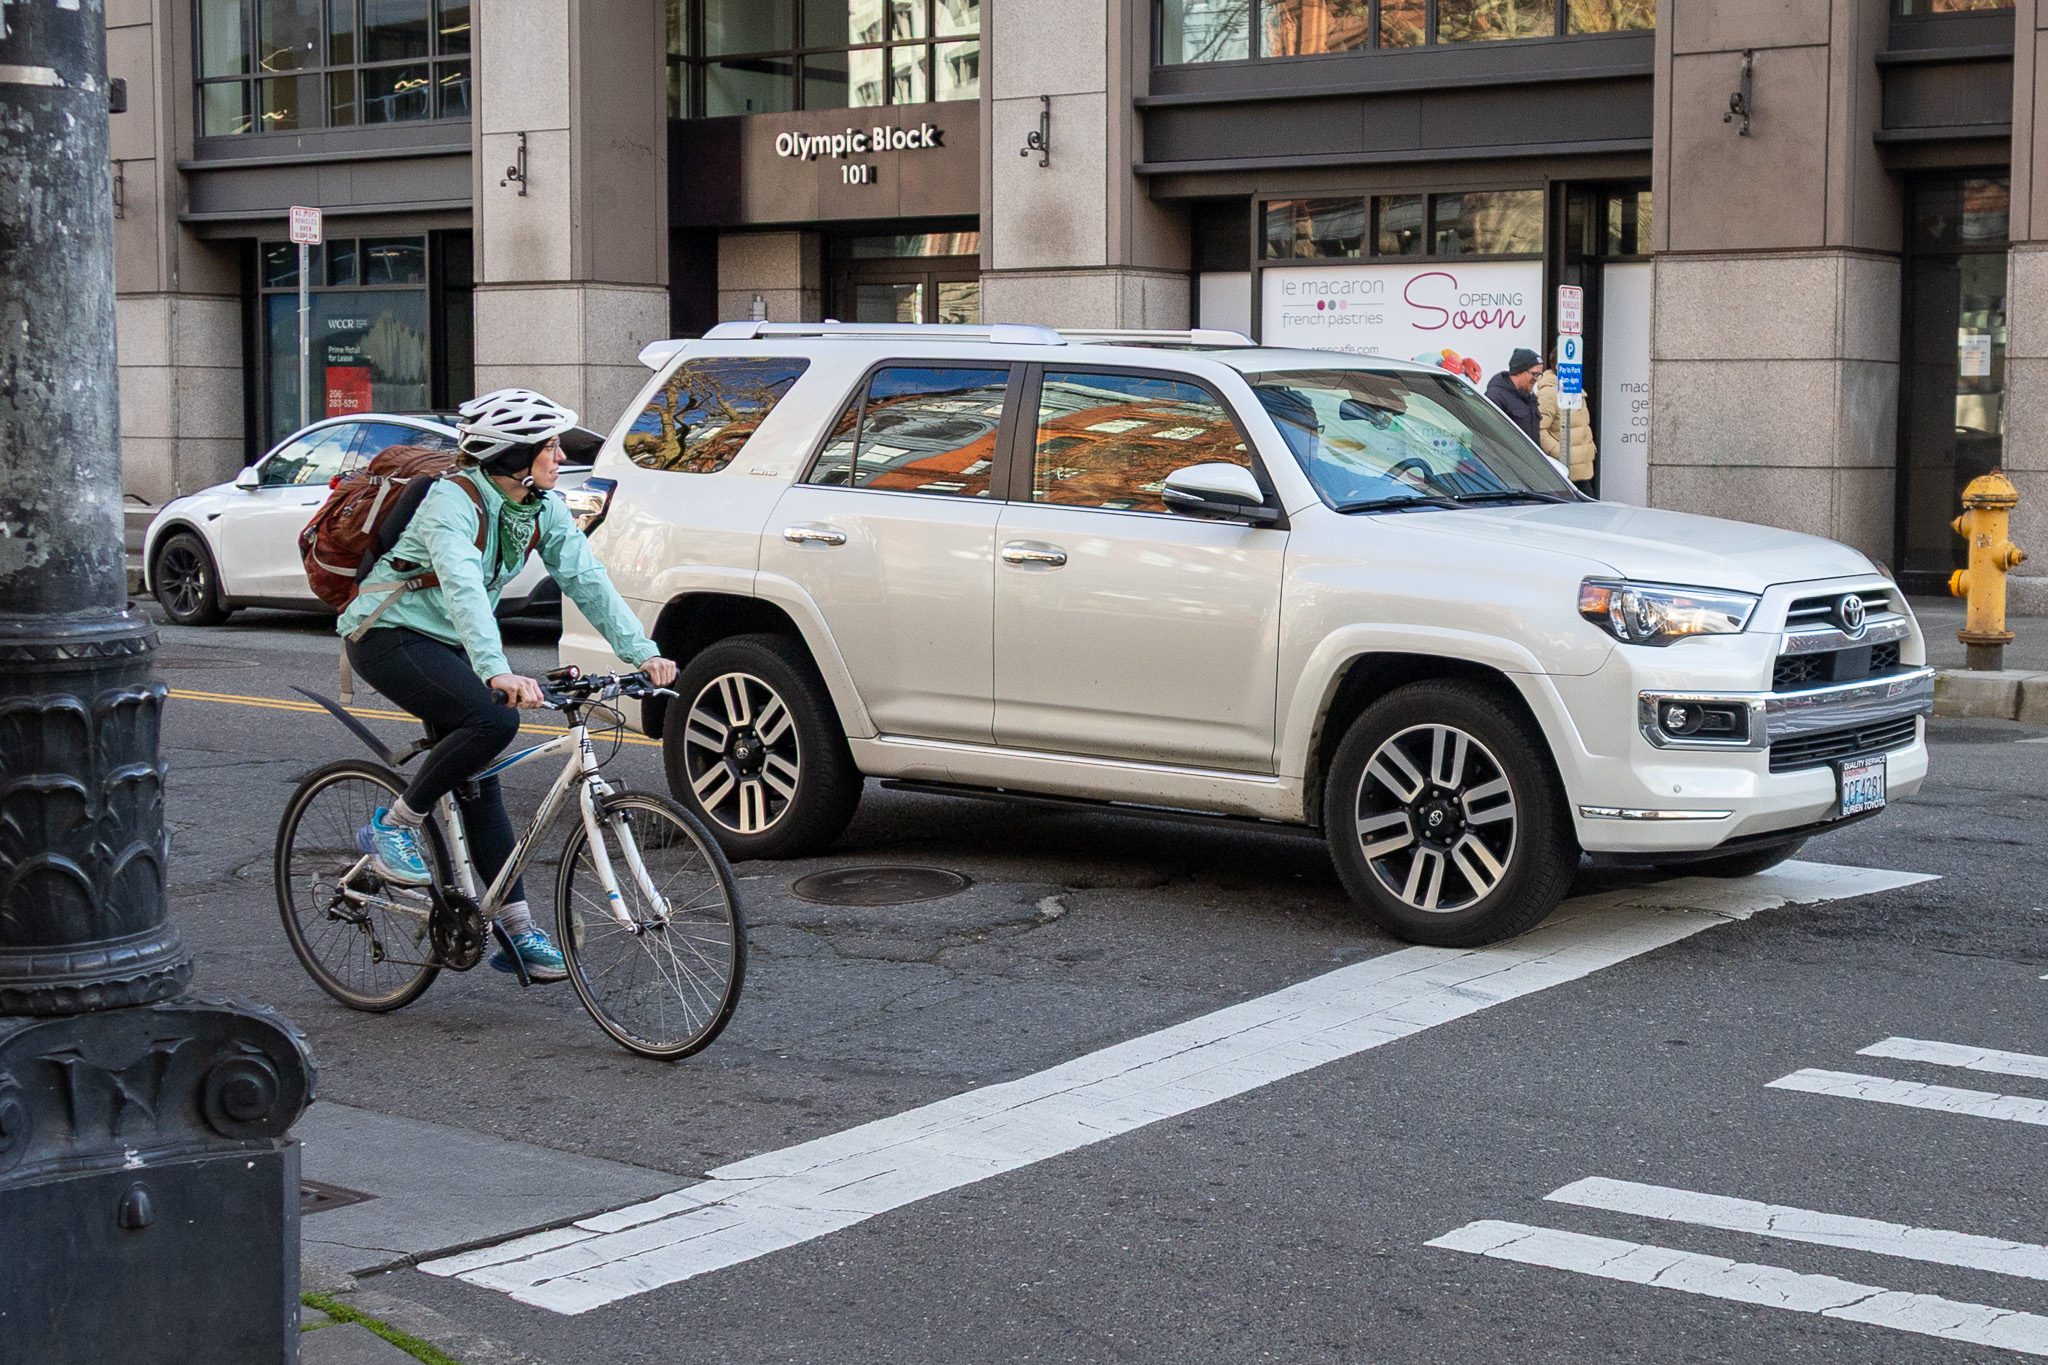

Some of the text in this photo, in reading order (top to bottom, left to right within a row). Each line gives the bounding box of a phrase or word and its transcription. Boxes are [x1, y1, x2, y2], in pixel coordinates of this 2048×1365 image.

[775, 122, 936, 161] Olympic Block
[841, 164, 867, 184] 101
[1281, 279, 1384, 295] le macaron
[1404, 271, 1526, 330] Soon
[1459, 292, 1523, 307] OPENING
[328, 319, 354, 329] WCCR
[1281, 312, 1384, 328] french pastries
[328, 345, 361, 354] Prime Retail
[1571, 366, 1581, 374] Park
[1621, 431, 1647, 443] and
[1844, 755, 1886, 770] QUALITY SERVICE
[1864, 799, 1886, 810] TOYOTA
